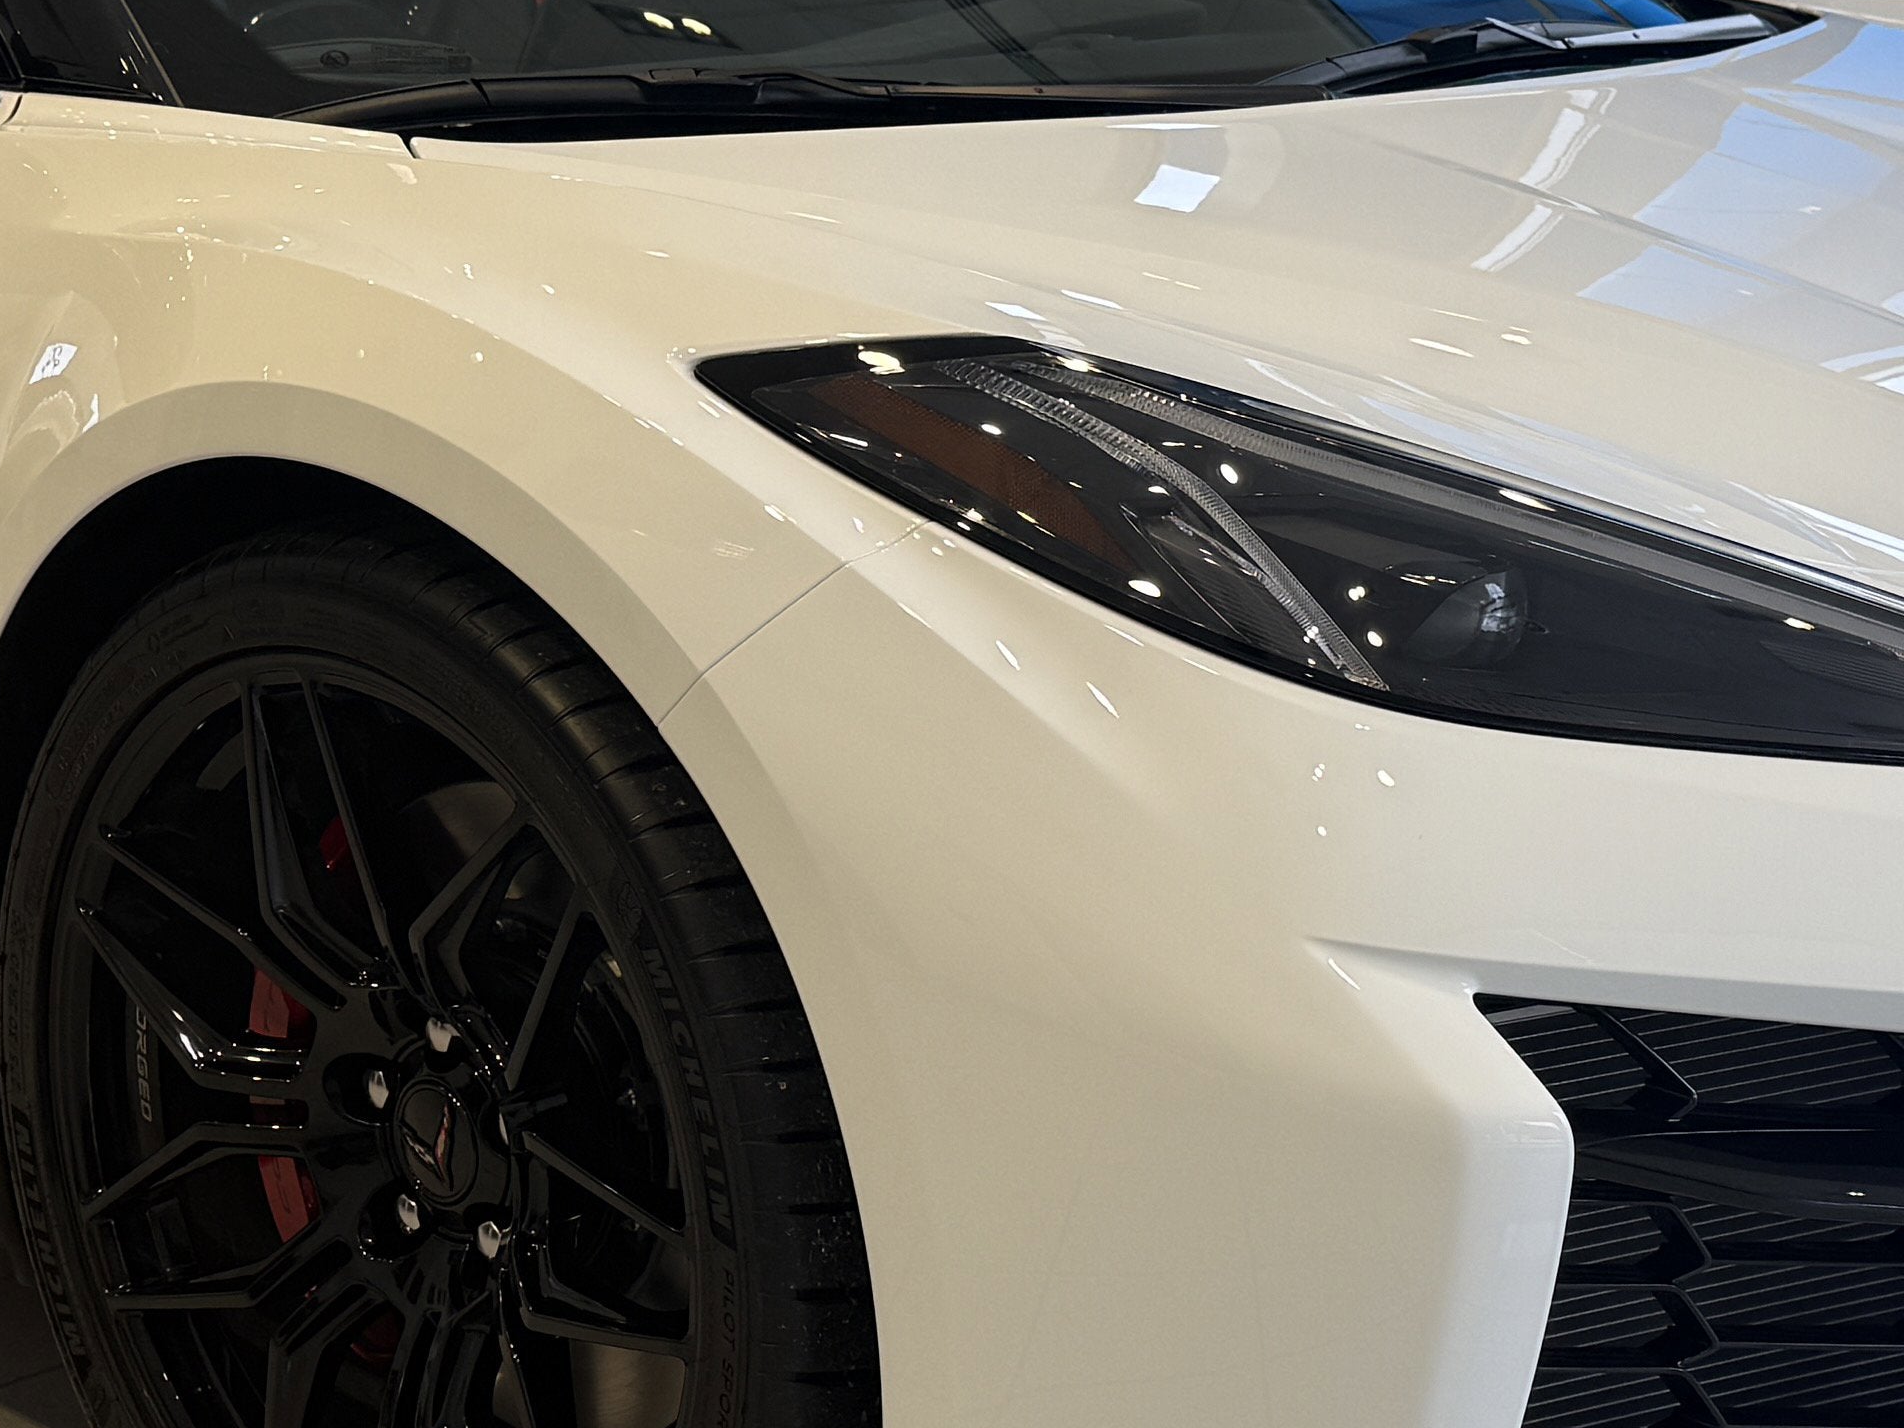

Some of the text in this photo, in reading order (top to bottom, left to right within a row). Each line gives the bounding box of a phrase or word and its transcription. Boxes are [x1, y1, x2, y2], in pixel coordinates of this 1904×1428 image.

[136, 1005, 153, 1122] ORGED
[641, 948, 734, 1232] MICHELIN
[14, 1116, 86, 1357] MICHELIN
[721, 1269, 736, 1352] PILOT
